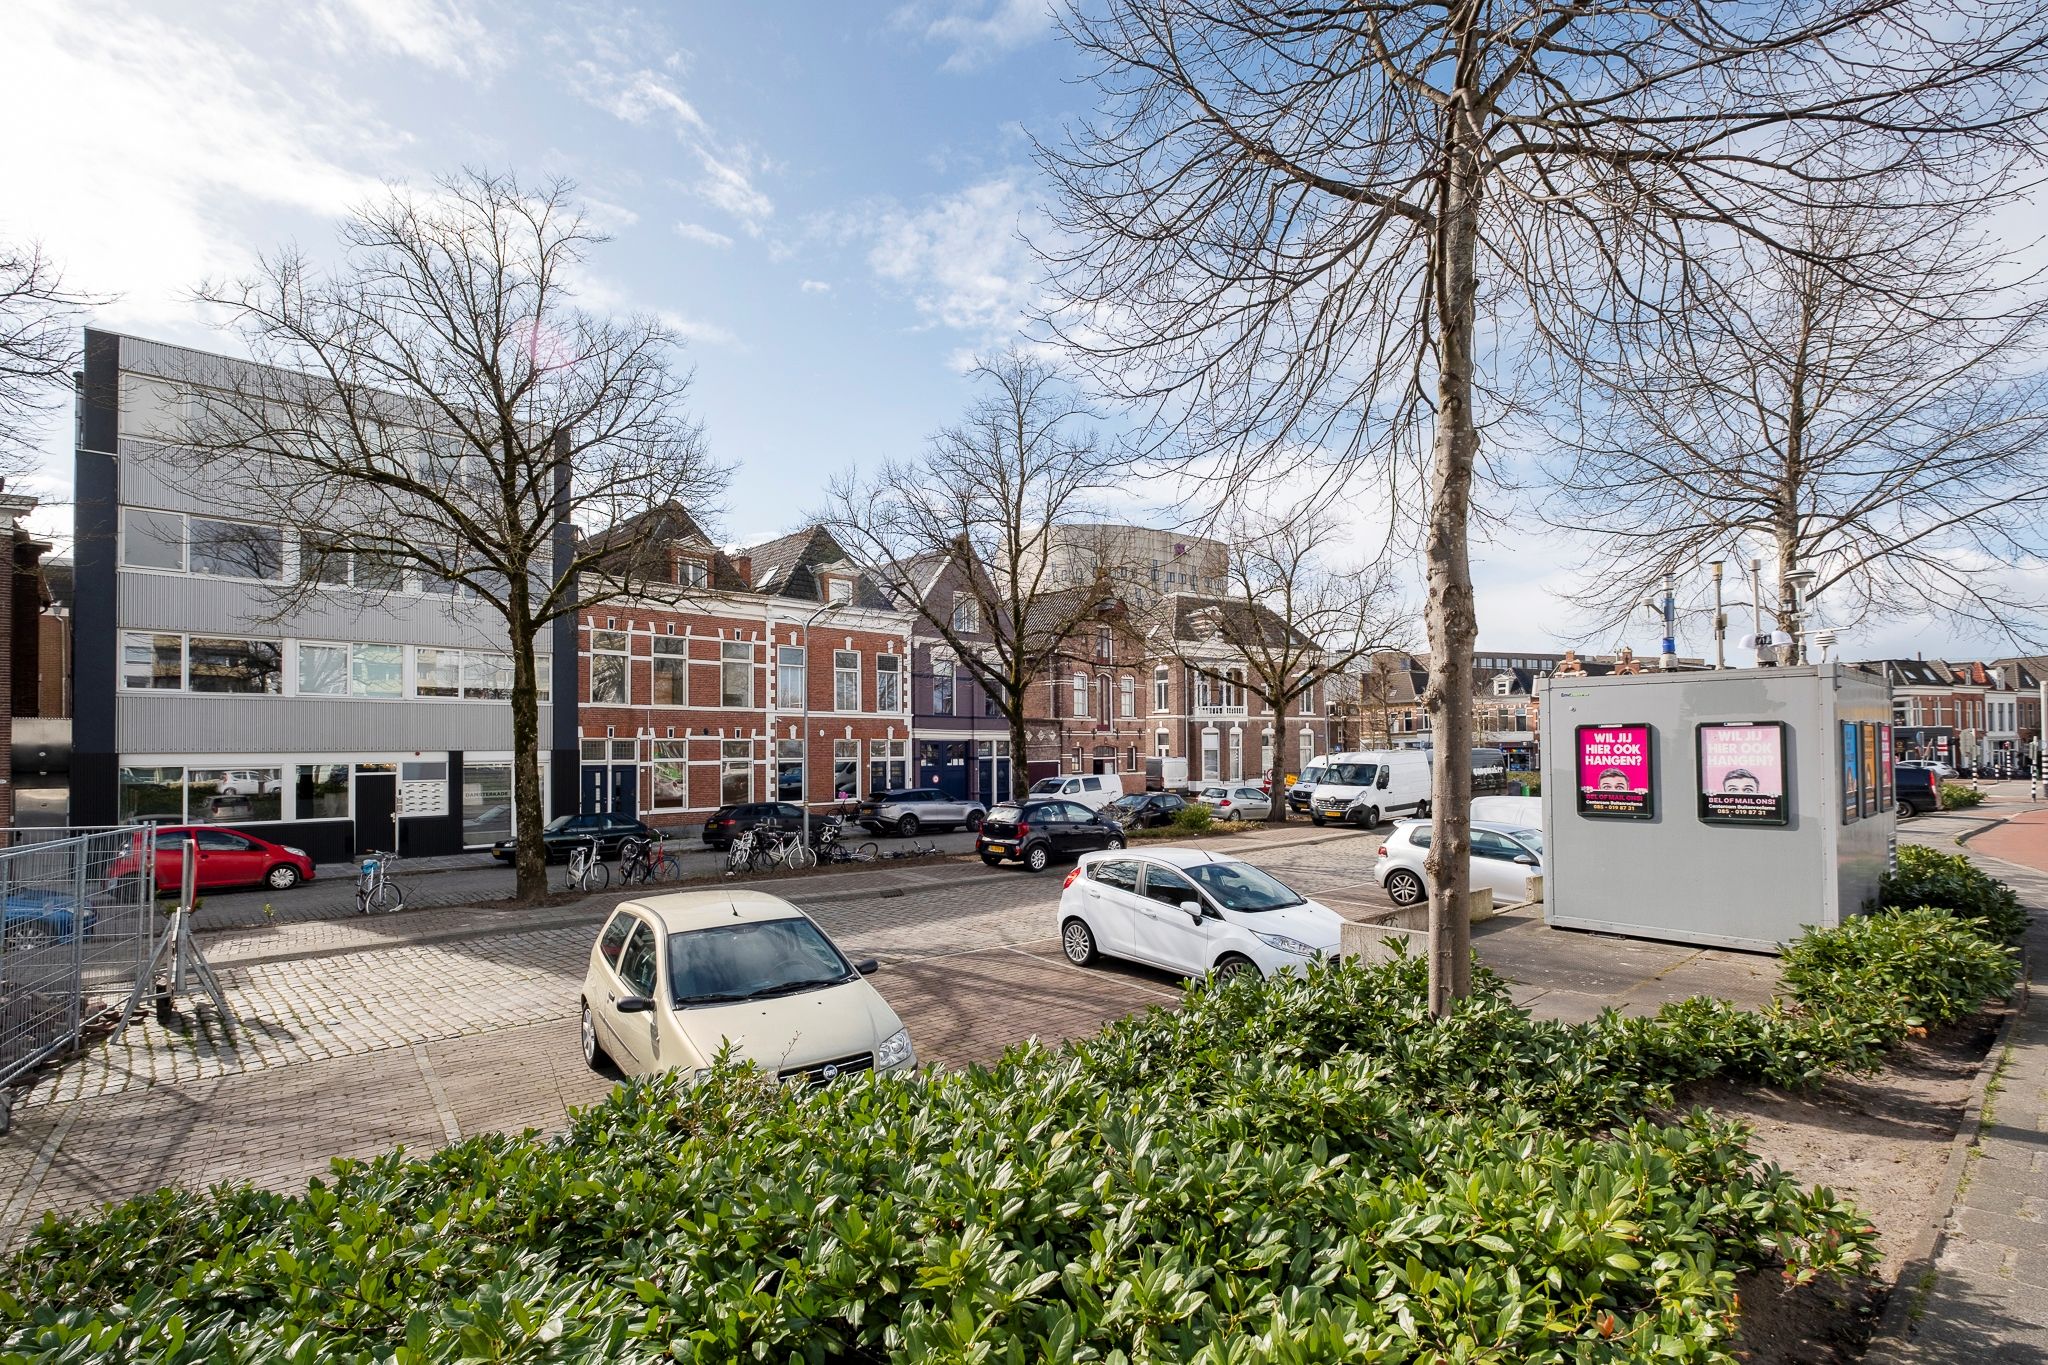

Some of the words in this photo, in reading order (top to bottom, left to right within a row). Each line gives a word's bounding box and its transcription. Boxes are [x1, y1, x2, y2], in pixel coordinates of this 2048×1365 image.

[1594, 732, 1616, 743] WIL
[1617, 732, 1632, 743] JIJ
[1719, 731, 1743, 741] WIL
[1744, 731, 1763, 741] JIJ
[1585, 744, 1611, 754] HIER
[1613, 744, 1641, 754] OOK
[1708, 742, 1738, 753] HIER
[1740, 742, 1773, 753] OOK
[1585, 755, 1642, 766] HANGEN?
[1708, 755, 1775, 766] HANGEN?
